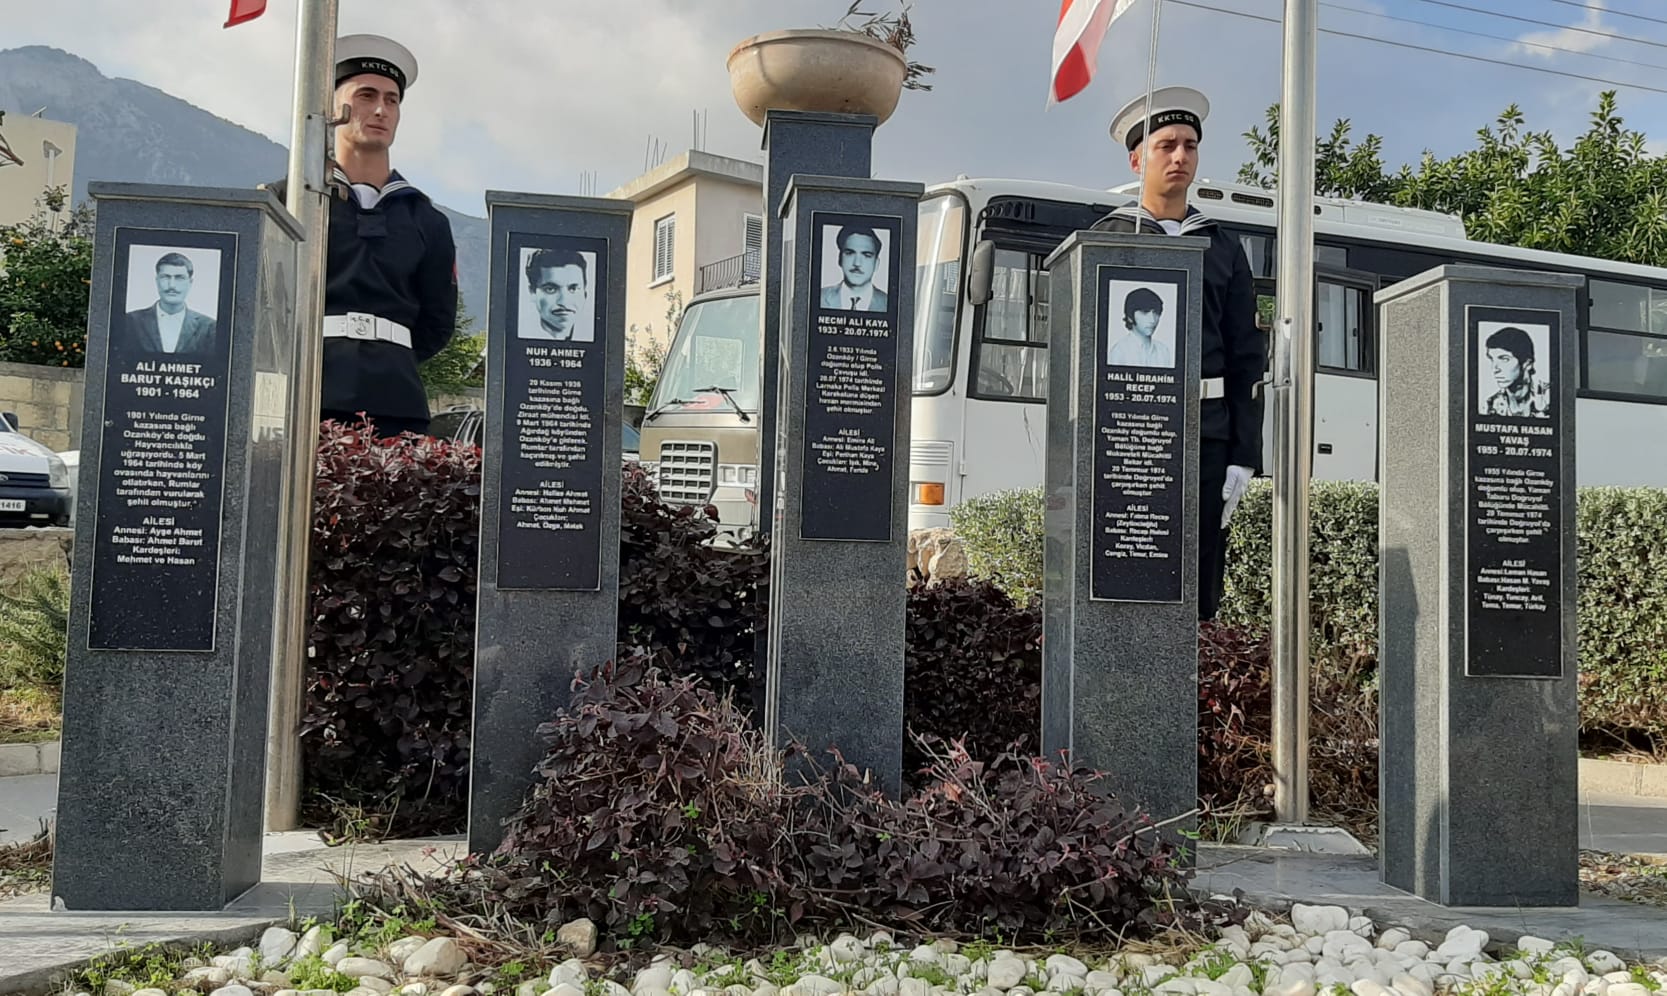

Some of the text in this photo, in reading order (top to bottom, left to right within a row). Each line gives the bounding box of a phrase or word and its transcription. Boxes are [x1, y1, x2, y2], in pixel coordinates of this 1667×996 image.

[361, 62, 387, 71] KKTC
[1158, 114, 1182, 123] KKTC
[818, 316, 846, 325] NECMİ
[849, 318, 862, 326] ALİ
[818, 326, 837, 334] 1933
[551, 349, 585, 357] AHMET
[136, 360, 201, 373] ALİ AHMET
[121, 374, 214, 388] BARUT KAŞIKÇI
[1108, 373, 1174, 383] HALİL İBRAHİM
[136, 387, 199, 398] 1901 1964
[1126, 384, 1155, 392] RECEP
[149, 412, 178, 420] Yılında
[1475, 424, 1553, 435] MUSTAFA HASAN
[1500, 436, 1529, 446] YAVAŞ
[186, 452, 205, 460] Mart
[146, 460, 184, 468] tarihinde
[168, 480, 200, 488] Rumlar
[143, 516, 174, 525] AİLESİ
[174, 528, 202, 536] Ahmet
[148, 537, 176, 545] Ahmet
[117, 555, 152, 563] Mehmet
[167, 557, 194, 565] Hasan
